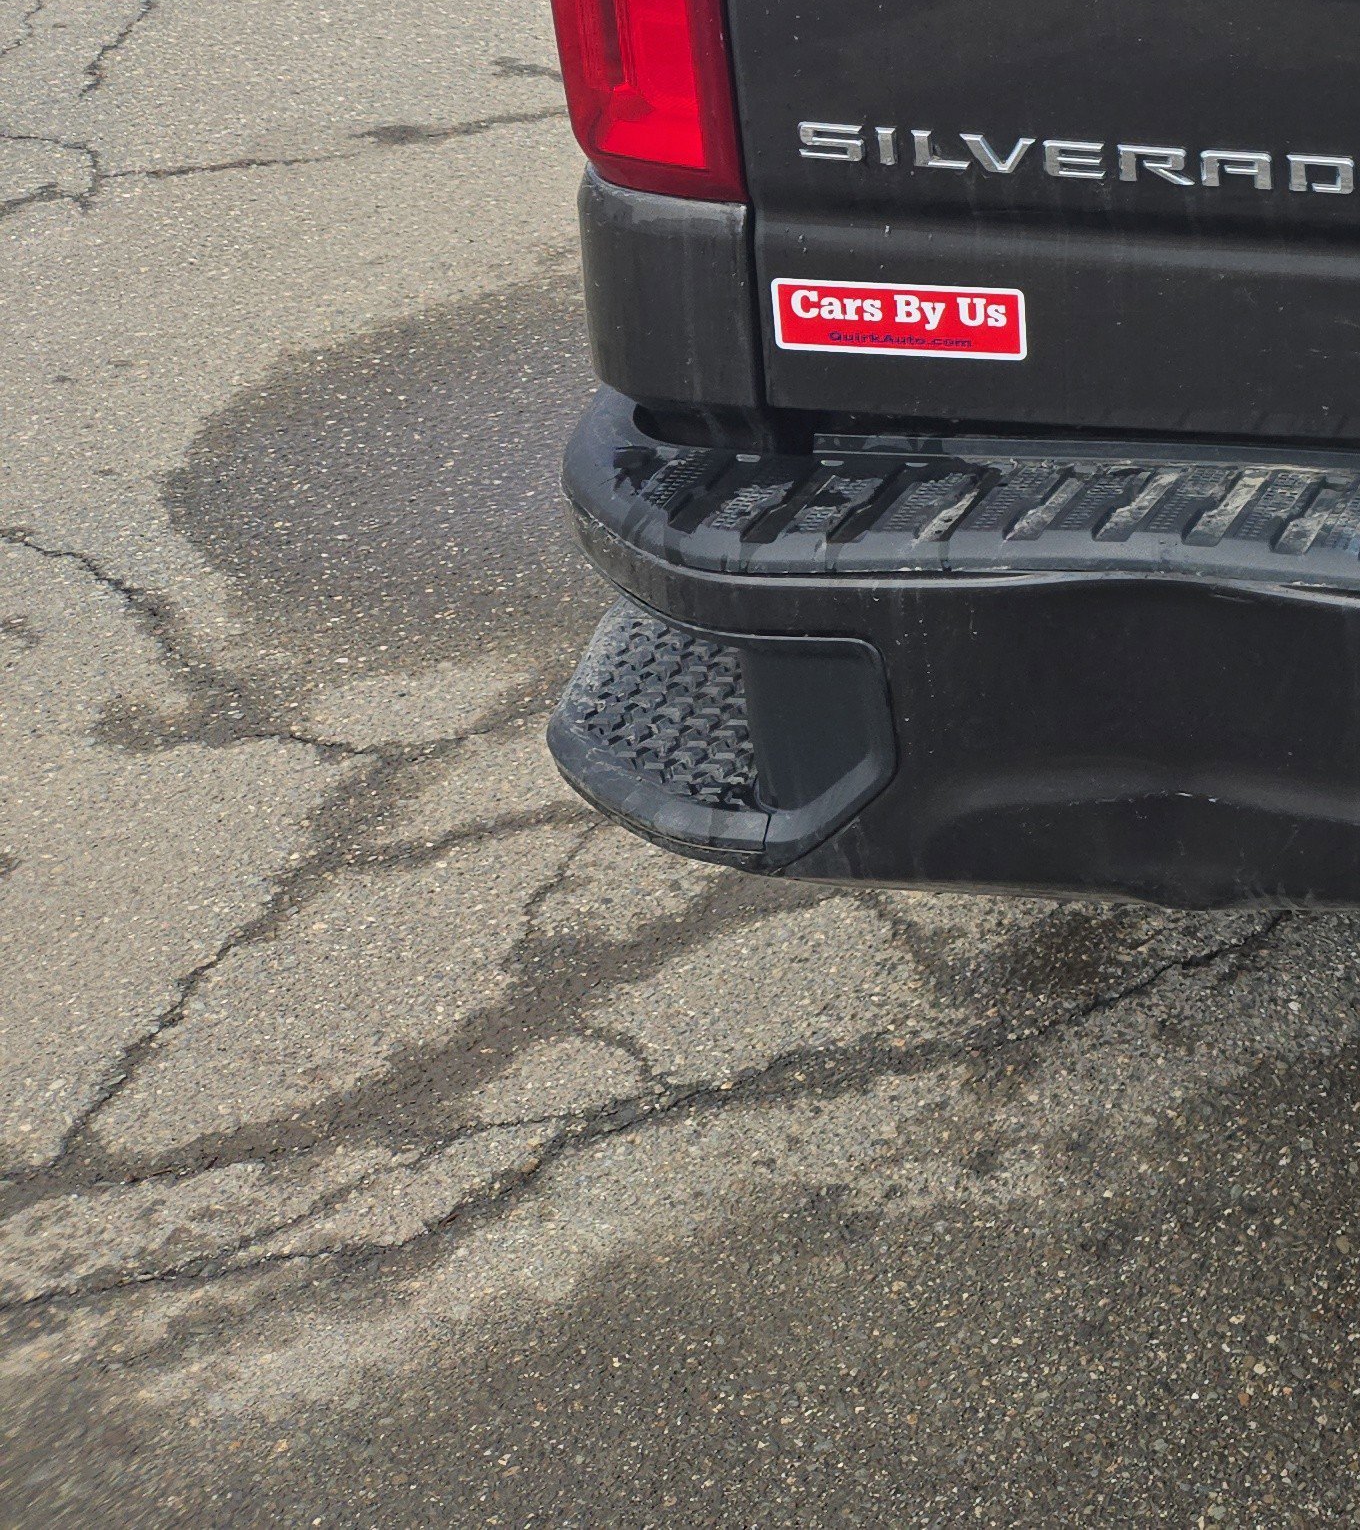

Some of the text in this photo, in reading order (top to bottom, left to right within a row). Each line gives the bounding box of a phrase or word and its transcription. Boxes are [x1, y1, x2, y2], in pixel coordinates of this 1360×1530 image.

[790, 289, 1008, 331] Cars By Us
